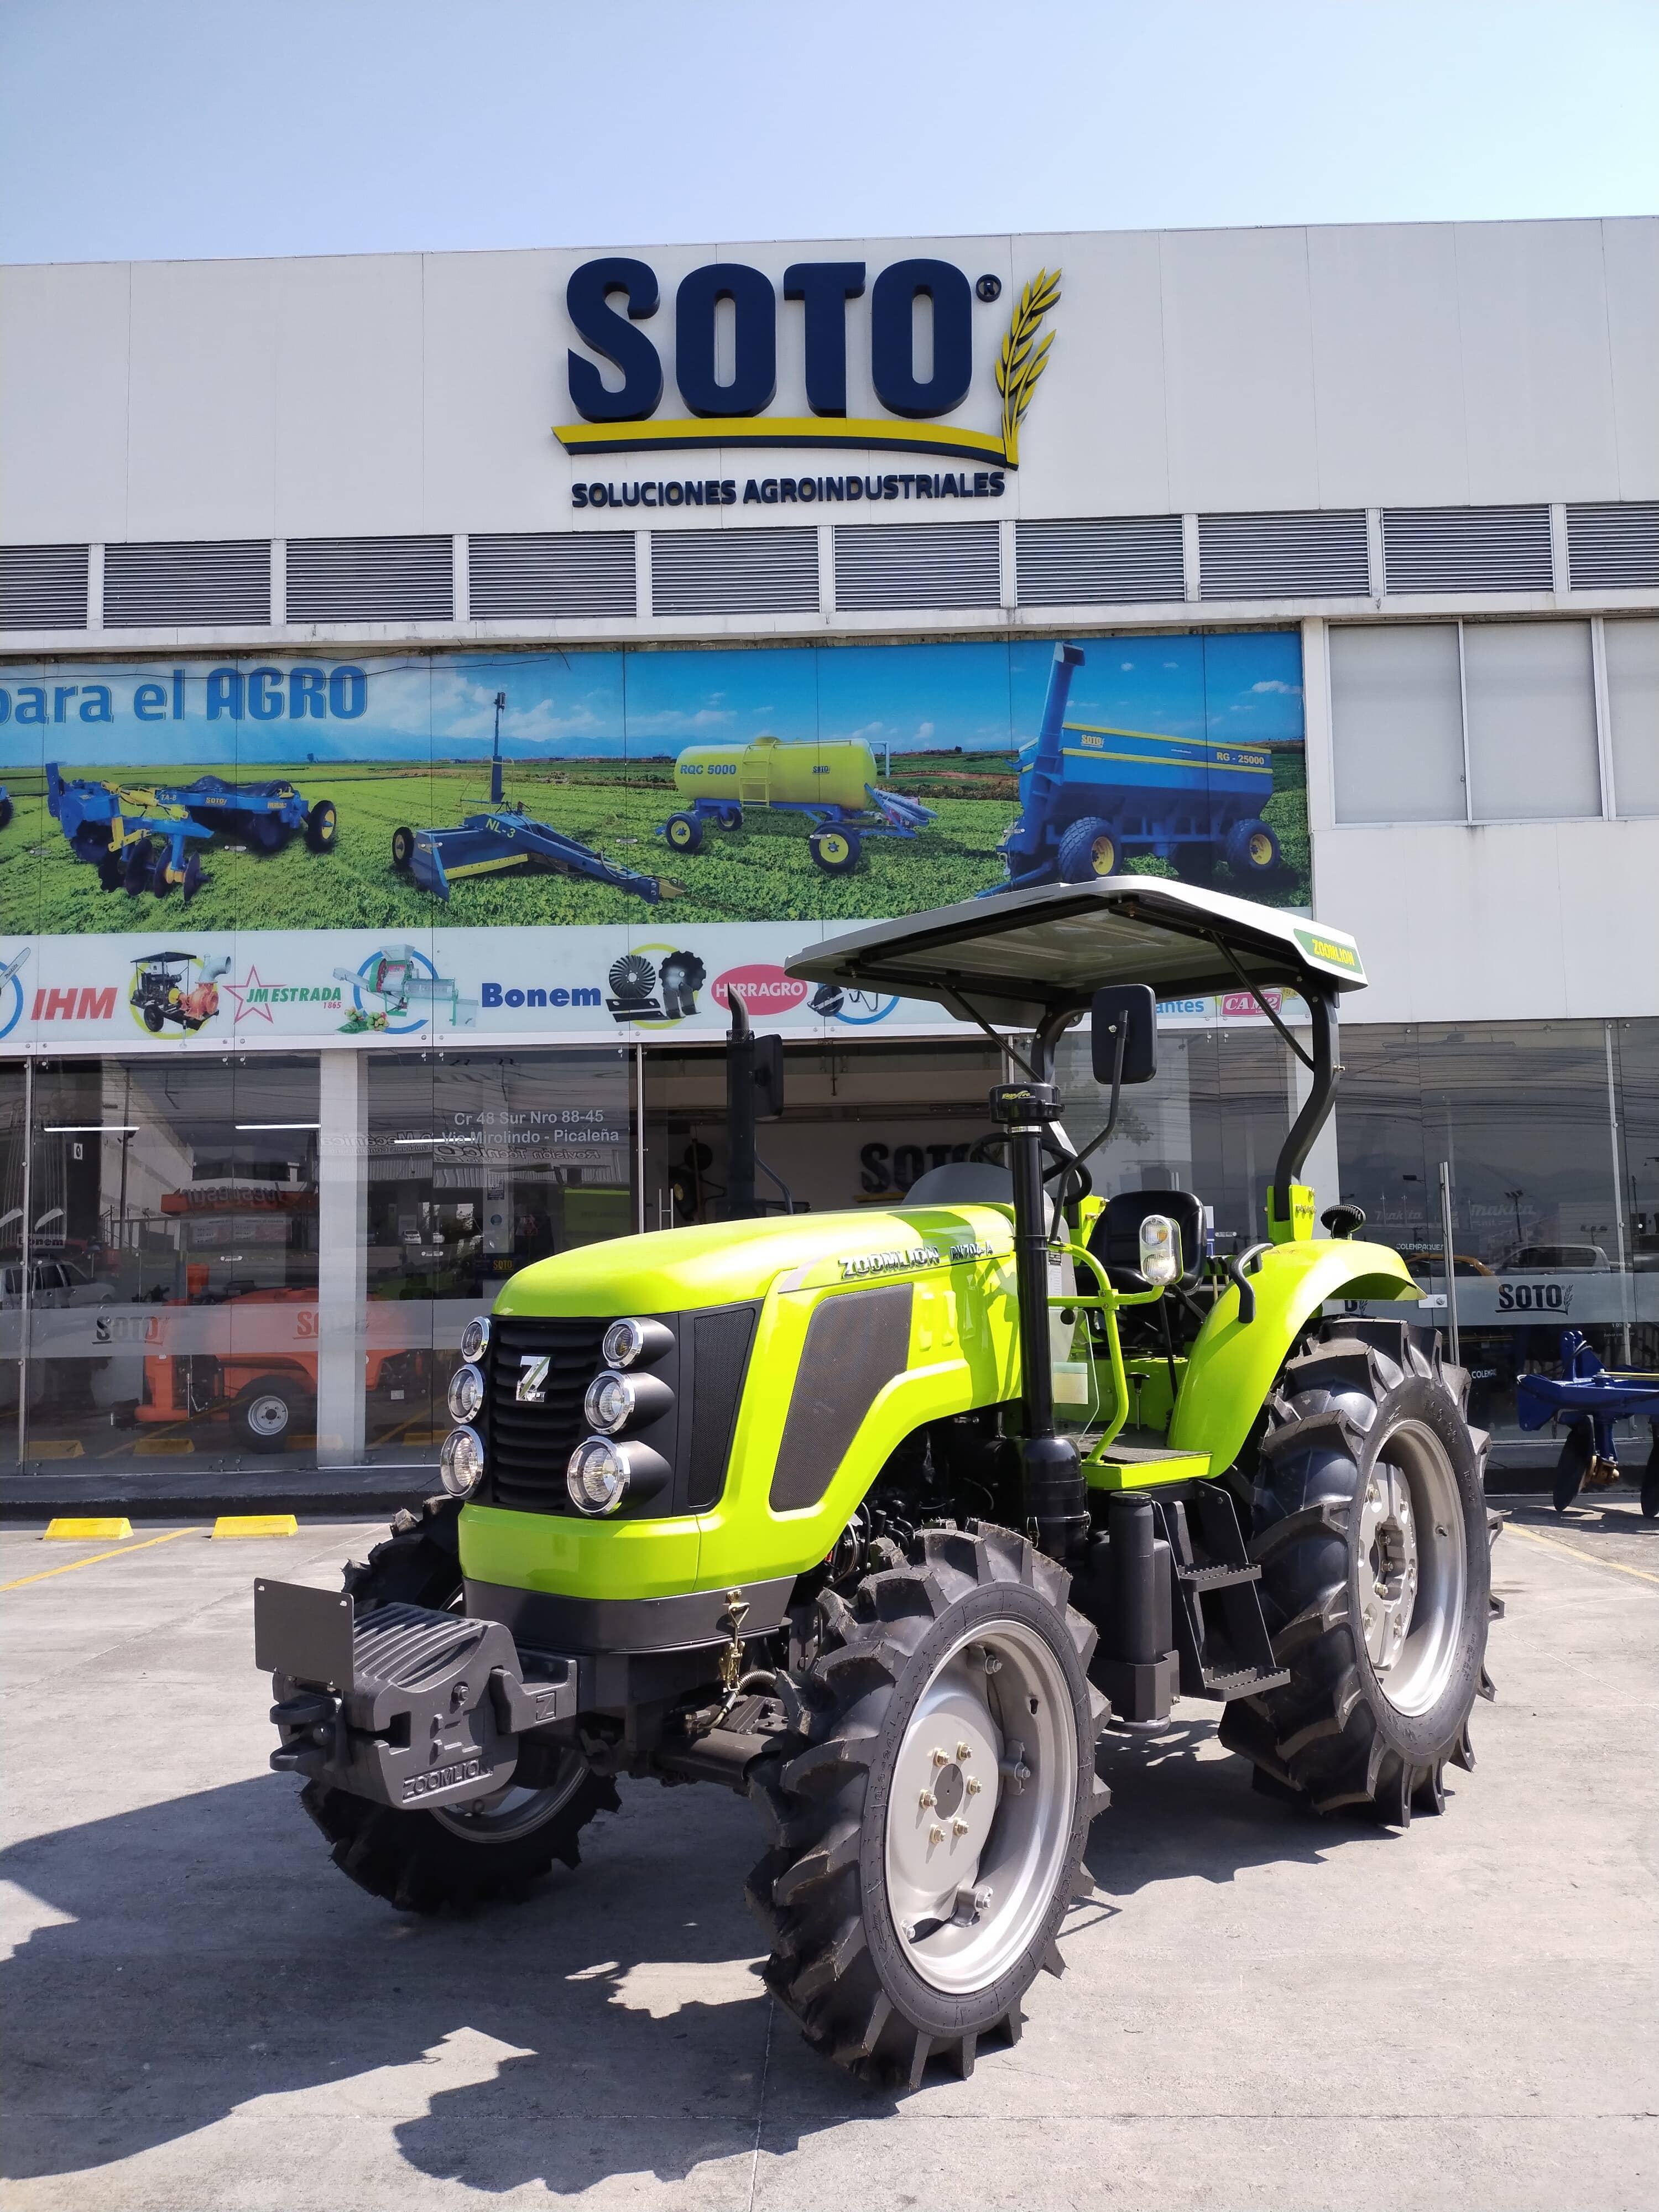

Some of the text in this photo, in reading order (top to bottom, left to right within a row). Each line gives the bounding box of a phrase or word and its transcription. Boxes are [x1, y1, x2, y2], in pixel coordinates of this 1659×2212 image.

[567, 257, 973, 422] SOTO
[572, 471, 1005, 508] SOLUCIONES AGROINDUSTRIALES
[134, 669, 186, 722] el
[207, 665, 368, 721] AGRO
[1082, 734, 1102, 746] SOTO
[680, 764, 736, 775] RQC 5000
[1217, 752, 1230, 761] RG
[1238, 754, 1265, 765] 25000
[486, 818, 515, 838] NL-3
[1312, 939, 1355, 966] ZOOMLION
[30, 987, 118, 1021] IHM
[246, 987, 342, 1003] JM ESTRADA
[482, 982, 601, 1008] Bonem
[454, 1109, 604, 1125] Cr 48 Sur Nro 88-45
[471, 1130, 540, 1144] Mirolindo
[554, 1128, 619, 1143] Picaleña
[493, 1260, 513, 1270] SOTO
[838, 1246, 941, 1280] ZOOMLION
[1499, 1284, 1562, 1309] SOTO
[96, 1316, 159, 1341] SOTO
[403, 1759, 493, 1799] ZOOMLION
